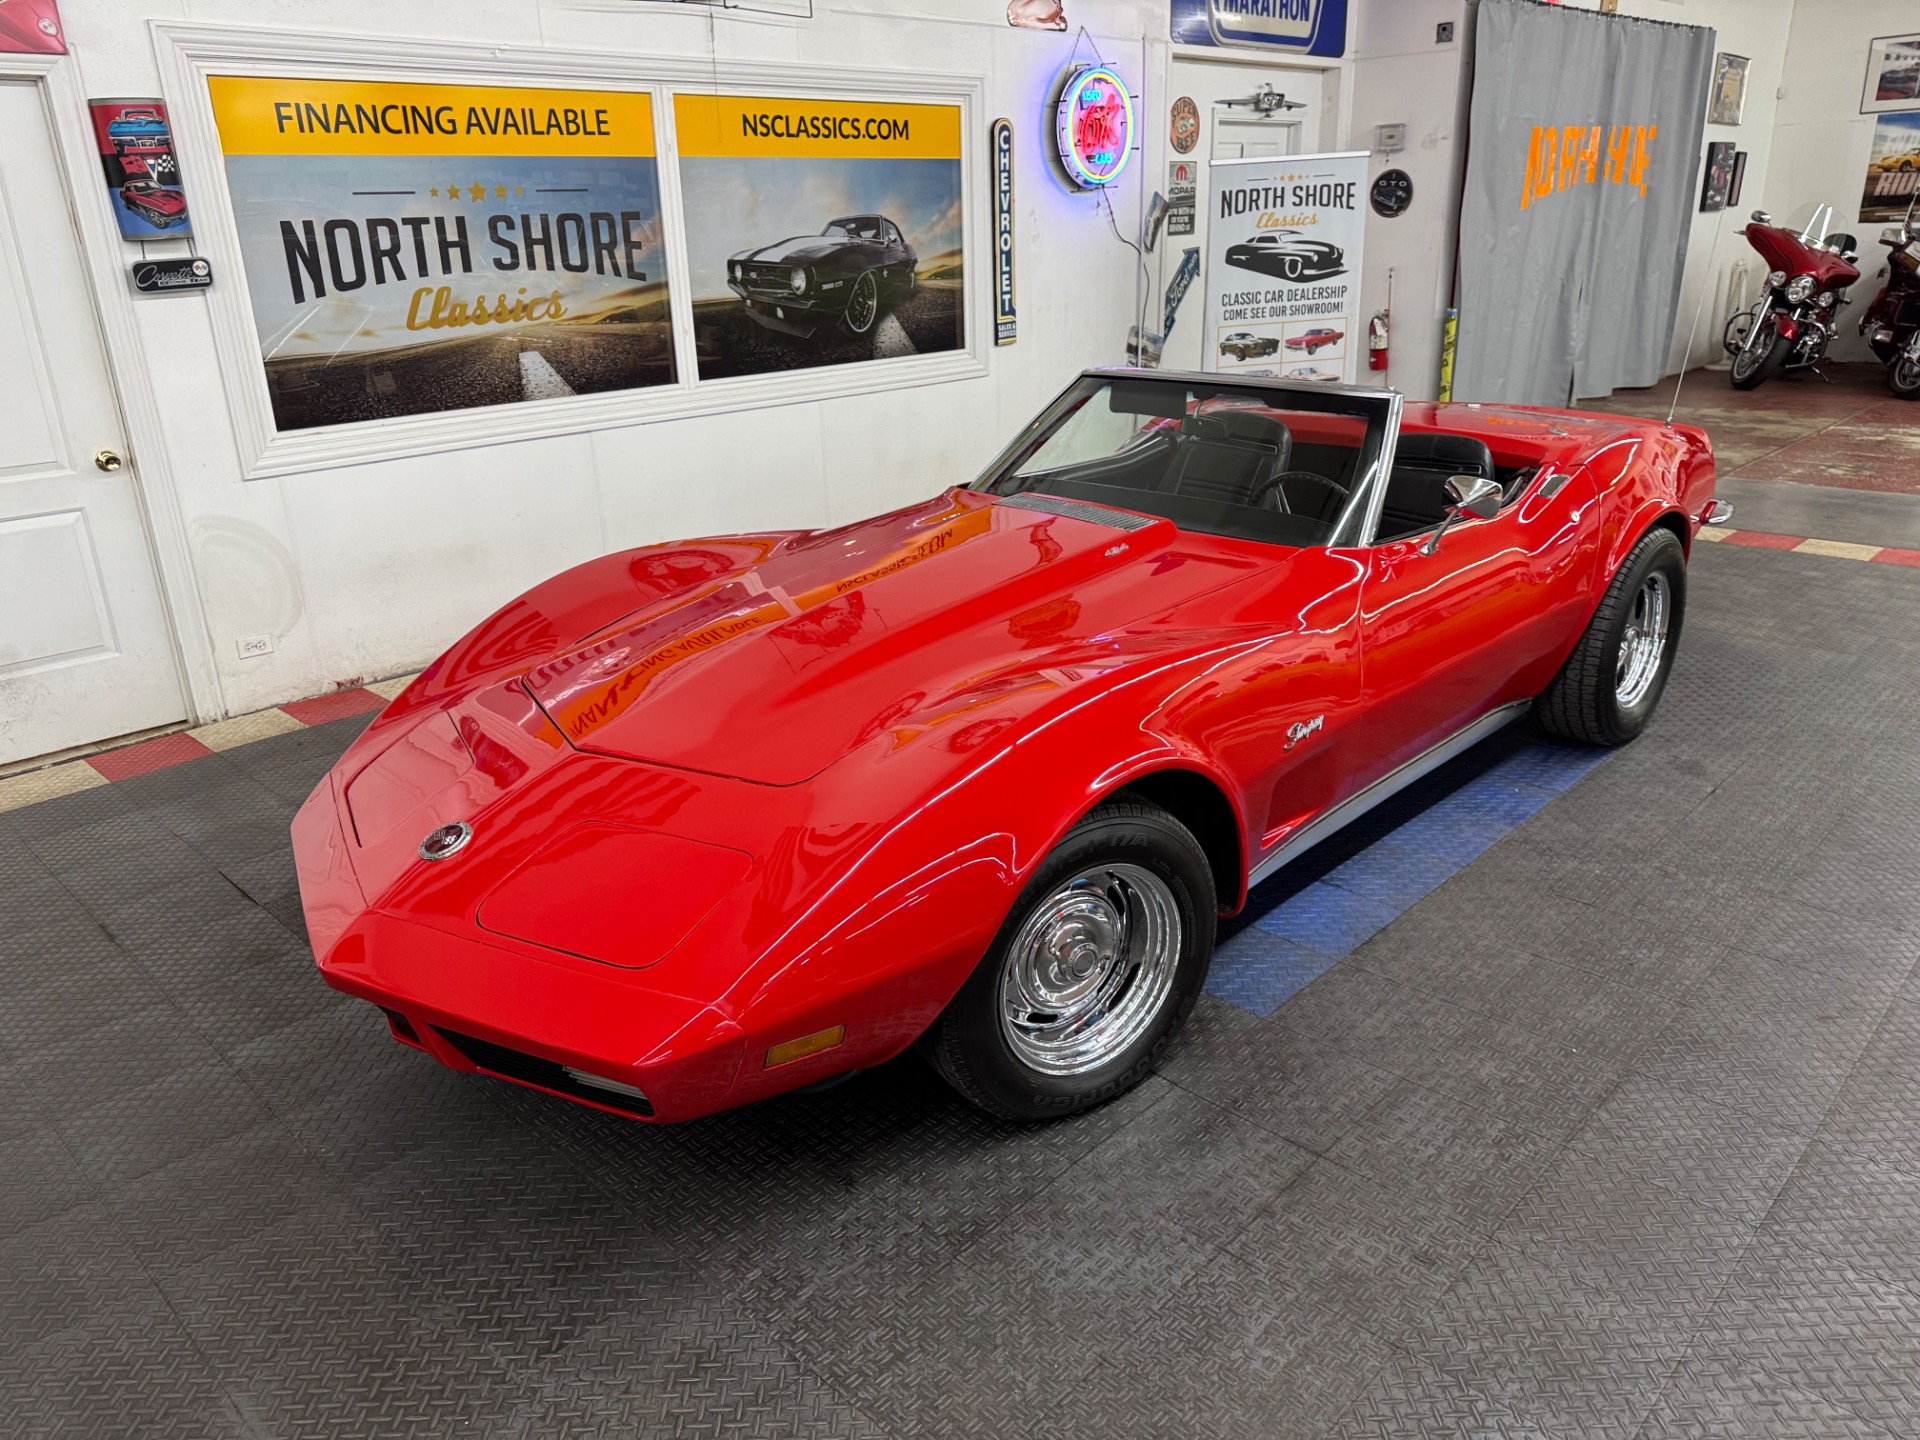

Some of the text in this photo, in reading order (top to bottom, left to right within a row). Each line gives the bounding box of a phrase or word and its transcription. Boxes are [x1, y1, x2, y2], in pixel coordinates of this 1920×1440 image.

[1224, 0, 1310, 22] MARATHON
[273, 102, 611, 136] FINANCING AVAILABLE
[1171, 99, 1197, 129] SUPER
[742, 113, 909, 141] NSCLASSICS.COM
[1176, 131, 1196, 151] BEE
[1169, 187, 1195, 195] MOPAR
[1873, 172, 1920, 196] RID
[1221, 182, 1357, 219] NORTH SHORE
[999, 130, 1011, 312] CHEVROLET
[1256, 212, 1318, 229] Classics
[279, 211, 648, 305] NORTH SHORE
[136, 264, 196, 287] Corvette
[1221, 285, 1348, 307] CLASSIC CAR DEALERSHIP
[406, 286, 569, 331] Classics
[1223, 302, 1344, 321] COME SEE OUR SHOWROOM!
[1109, 832, 1149, 848] T/A
